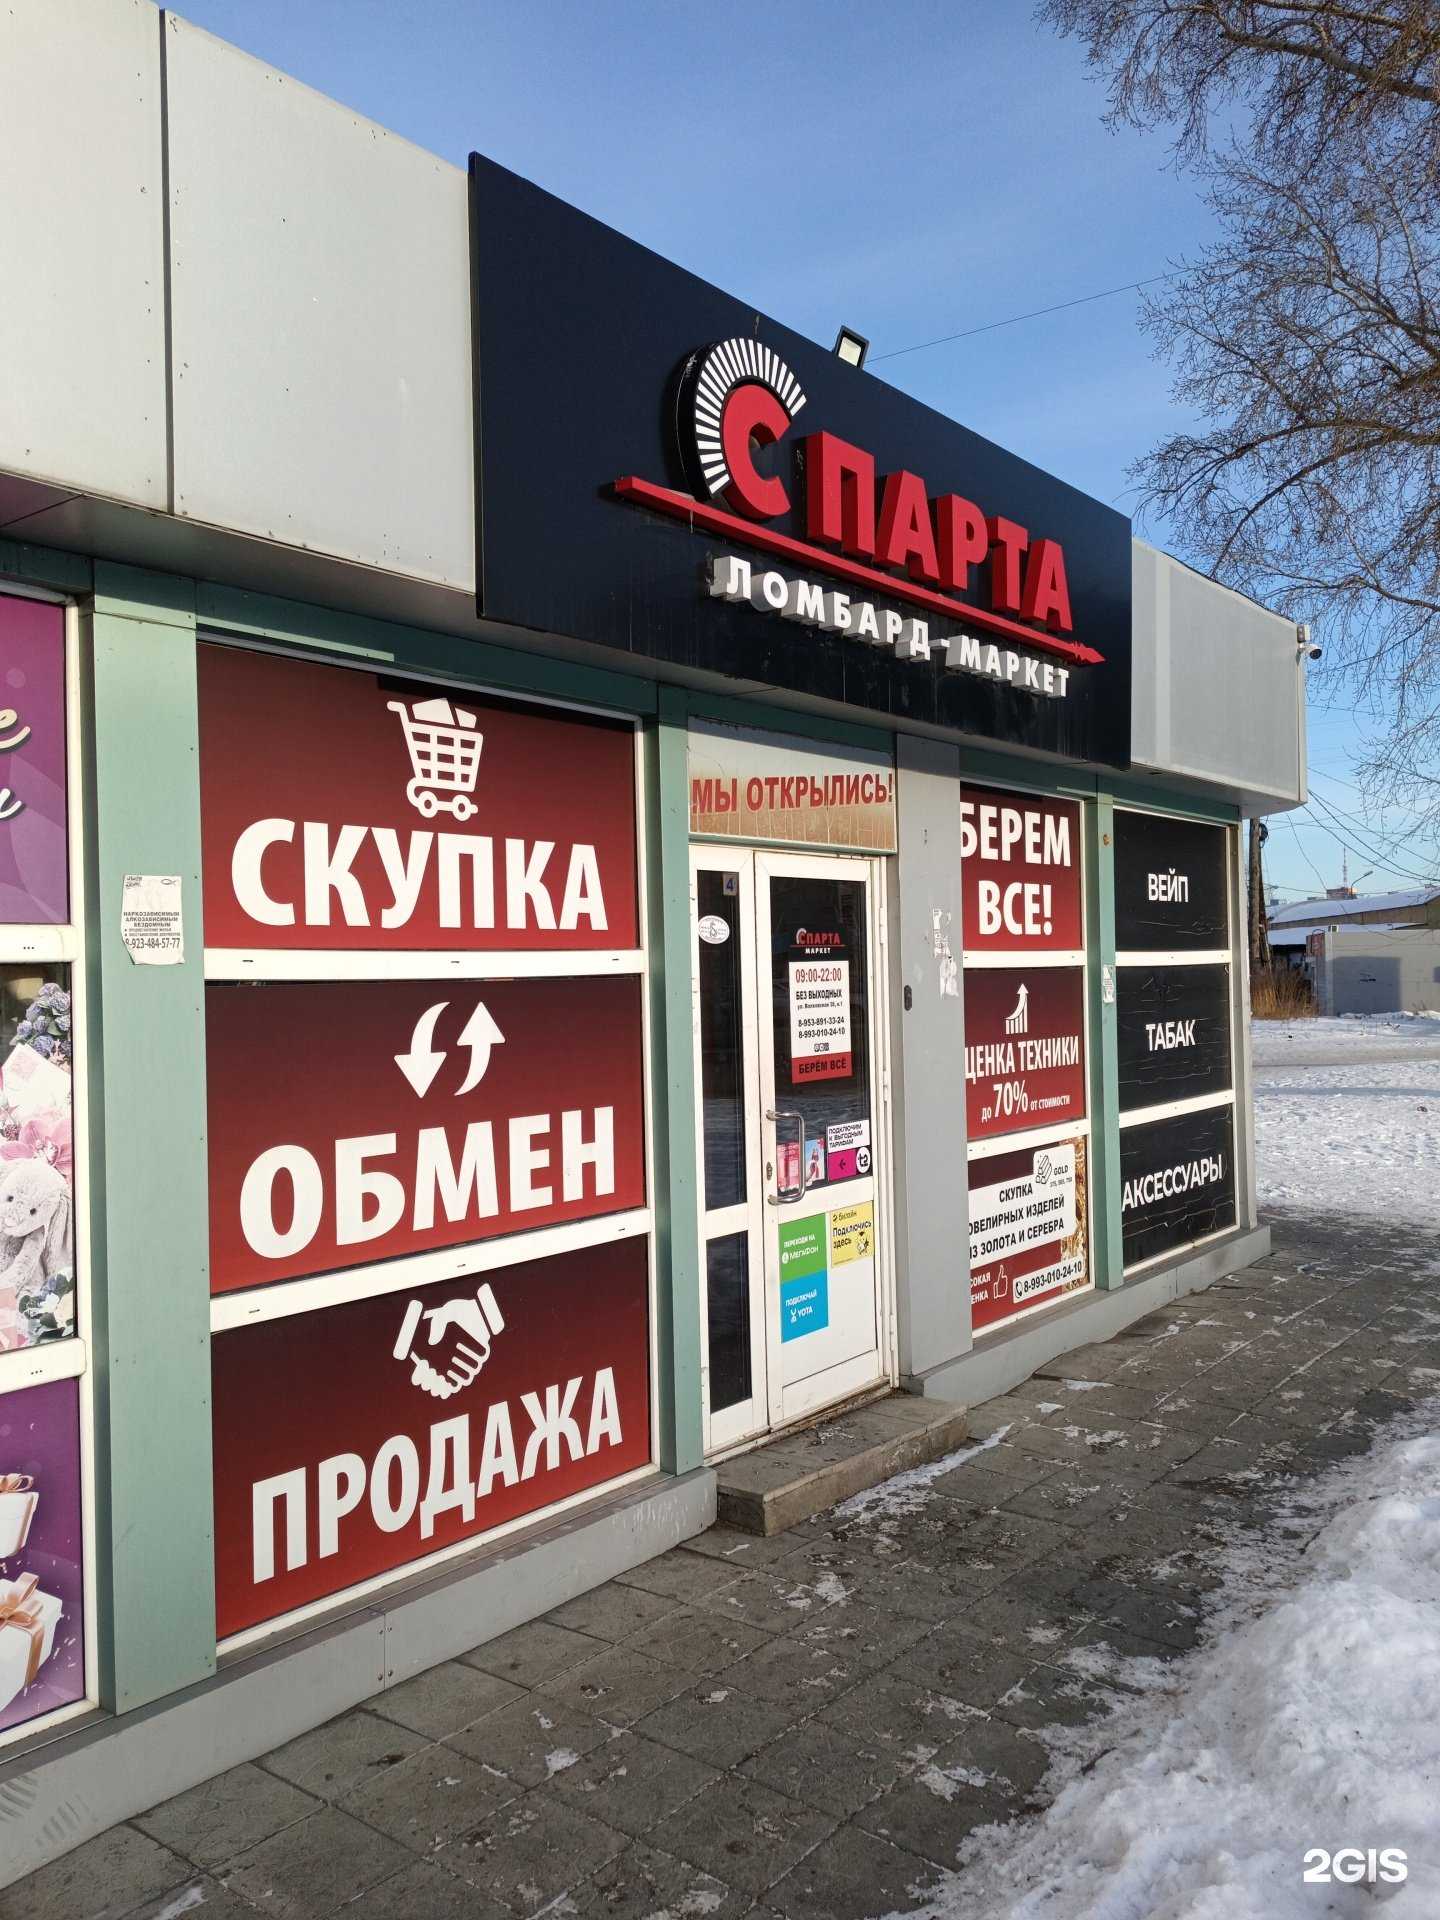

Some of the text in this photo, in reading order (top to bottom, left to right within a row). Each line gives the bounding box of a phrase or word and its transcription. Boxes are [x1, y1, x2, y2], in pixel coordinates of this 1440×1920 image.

[712, 365, 1074, 633] СПАРТА
[710, 555, 1070, 698] ЛОМБАРД-МАРКЕТ
[691, 773, 893, 814] МЫ ОТКРЫЛИСЬ!
[960, 801, 1072, 867] БЕРЕМ
[230, 816, 609, 933] СКУПКА
[726, 878, 734, 892] 4
[1148, 868, 1189, 902] ВЕЙП
[978, 879, 1053, 936] ВСЕ!
[796, 928, 841, 945] СПАРТА
[795, 967, 842, 983] 09:00-22:00
[796, 988, 842, 1001] БЕЗ ВЫХОДНЫХ
[798, 1027, 845, 1039] 8-993-010-24-10
[1145, 1019, 1196, 1051] ТАБАК
[1018, 1036, 1079, 1072] ТЕХНИКИ
[993, 1080, 1029, 1118] 70%
[829, 1138, 854, 1148] ТАРИФАМ
[239, 1105, 617, 1260] ОБМЕН
[1053, 1165, 1069, 1176] GOLD
[1121, 1154, 1223, 1212] АКСЕССУАРЫ
[999, 1182, 1033, 1203] СКУПКА
[1026, 1193, 1065, 1218] ИЗДЕЛЕЙ
[832, 1220, 872, 1237] Подключись
[833, 1238, 852, 1249] здесь
[980, 1233, 1017, 1256] ЗОЛОТА
[1019, 1230, 1025, 1243] И
[1027, 1217, 1065, 1240] СЕРЕБРА
[1023, 1260, 1082, 1293] 8-993-010-24-10
[252, 1365, 625, 1586] ПРОДАЖА
